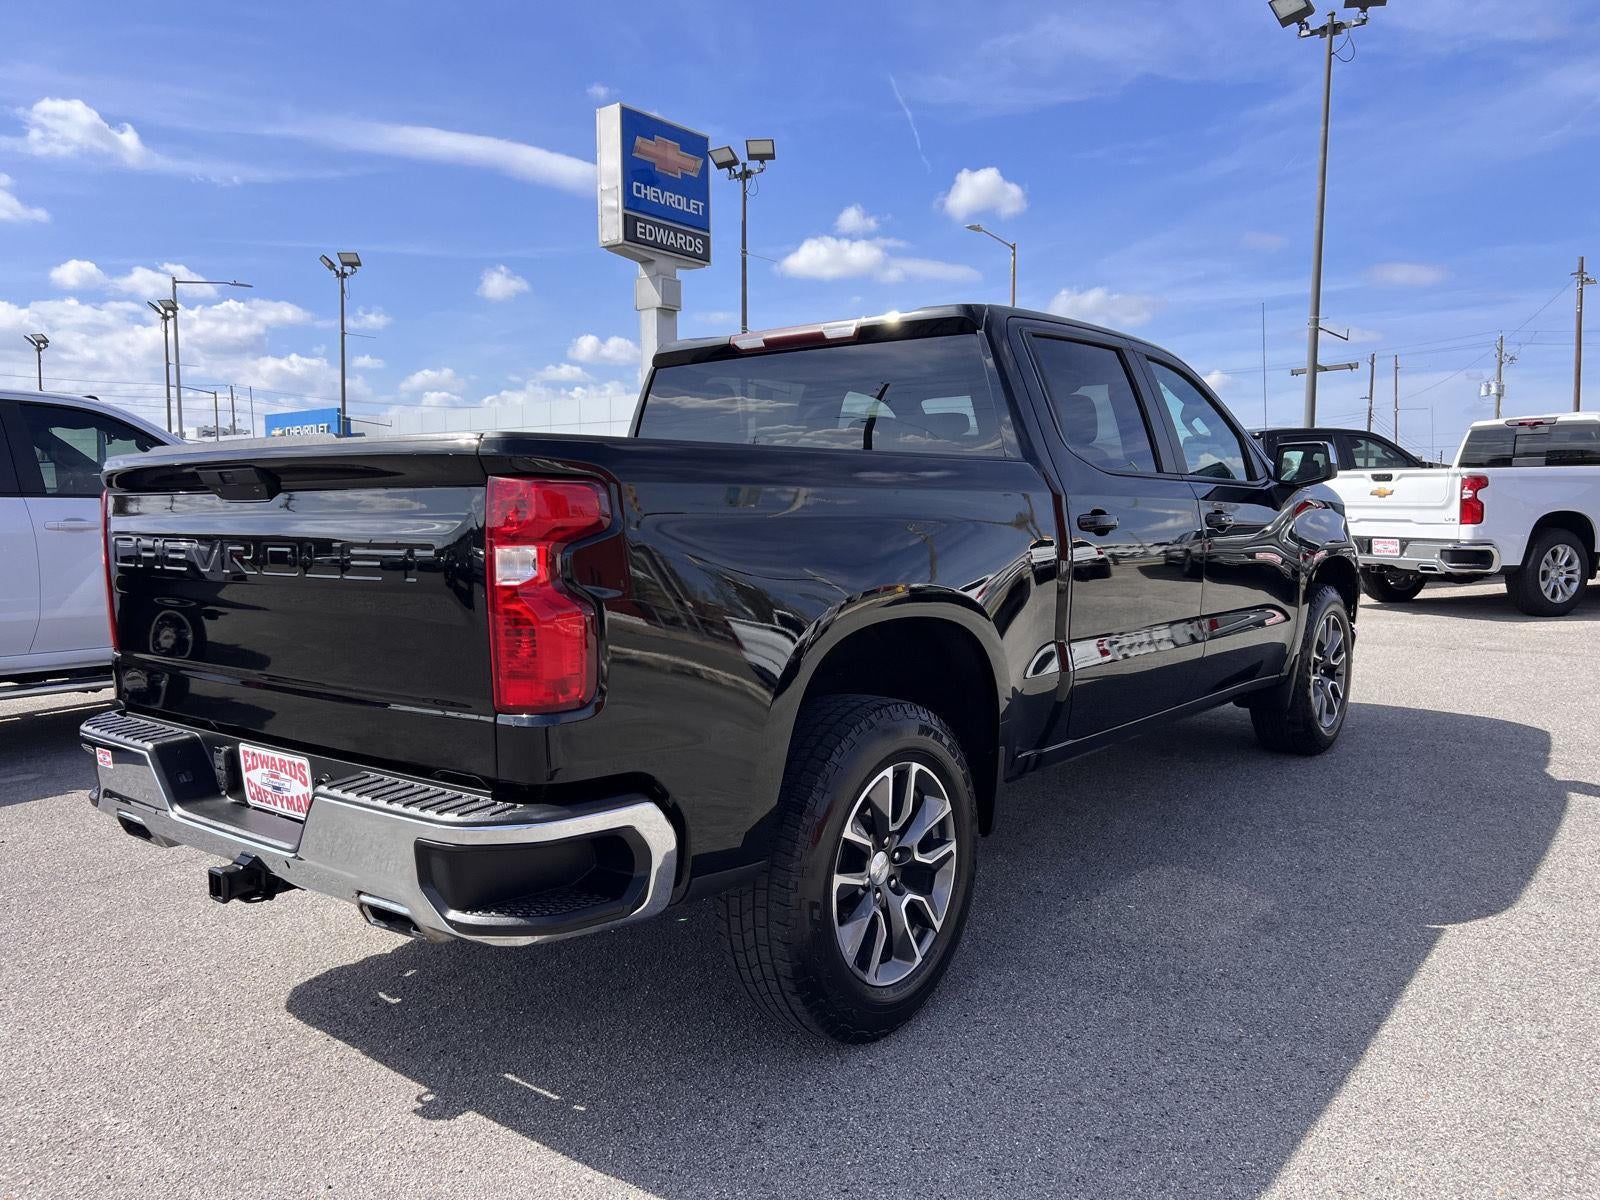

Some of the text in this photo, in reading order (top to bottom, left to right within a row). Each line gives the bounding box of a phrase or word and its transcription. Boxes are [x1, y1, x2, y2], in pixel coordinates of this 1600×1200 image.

[632, 181, 704, 216] CHEVROLET
[636, 221, 703, 254] EDWARDS
[285, 423, 328, 436] CHEVROLET
[114, 535, 436, 584] CHEVROLET
[242, 750, 308, 787] EDWARDS
[247, 777, 309, 814] CHEVYMAN
